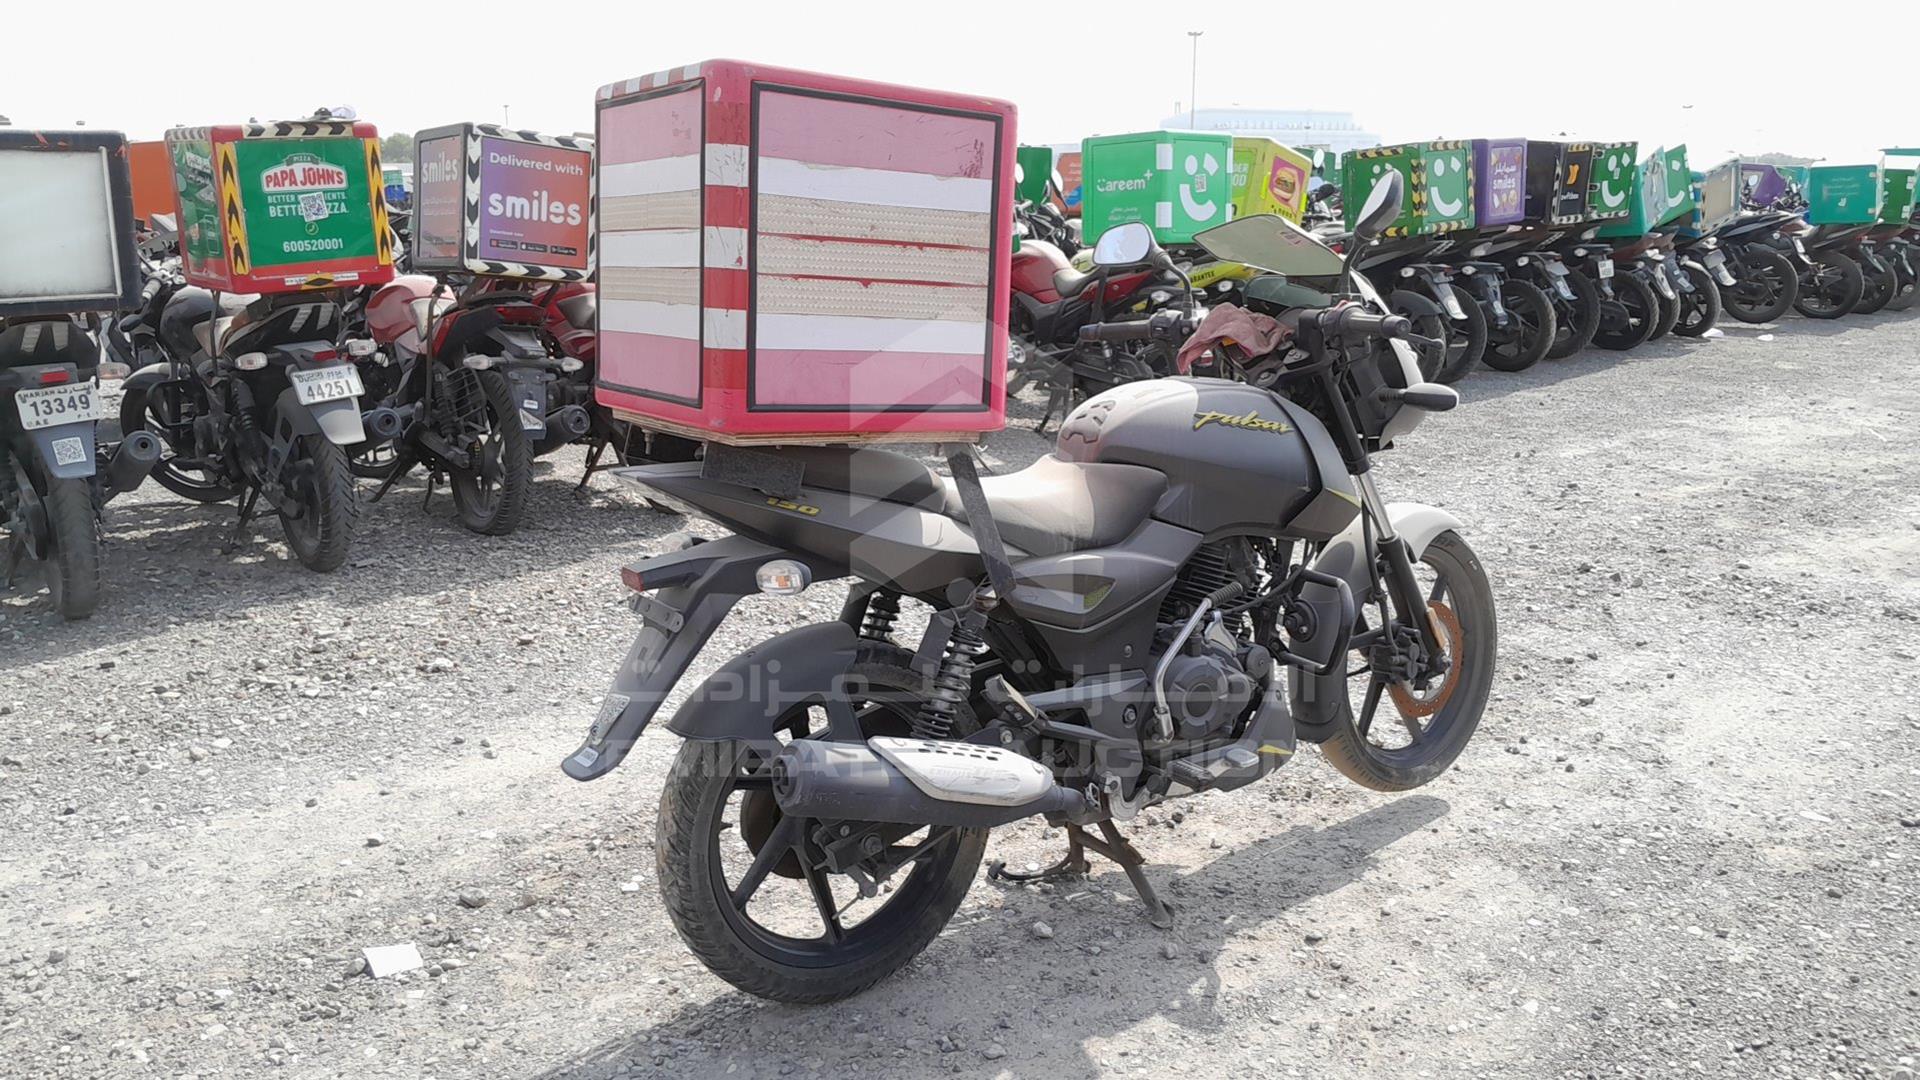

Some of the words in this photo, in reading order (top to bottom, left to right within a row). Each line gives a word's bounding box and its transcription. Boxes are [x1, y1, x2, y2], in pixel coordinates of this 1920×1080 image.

[422, 152, 458, 184] smiles
[490, 152, 551, 171] Delivered
[555, 163, 584, 176] with
[265, 168, 298, 188] PAPA
[300, 167, 344, 187] JOHN'S
[1492, 176, 1516, 190] smiles
[267, 194, 296, 204] BETTER
[488, 190, 583, 226] smiles
[269, 204, 305, 217] BETTE
[283, 238, 343, 252] 600520001
[307, 379, 353, 400] 44251
[29, 394, 90, 417] 13349
[767, 497, 820, 517] 150
